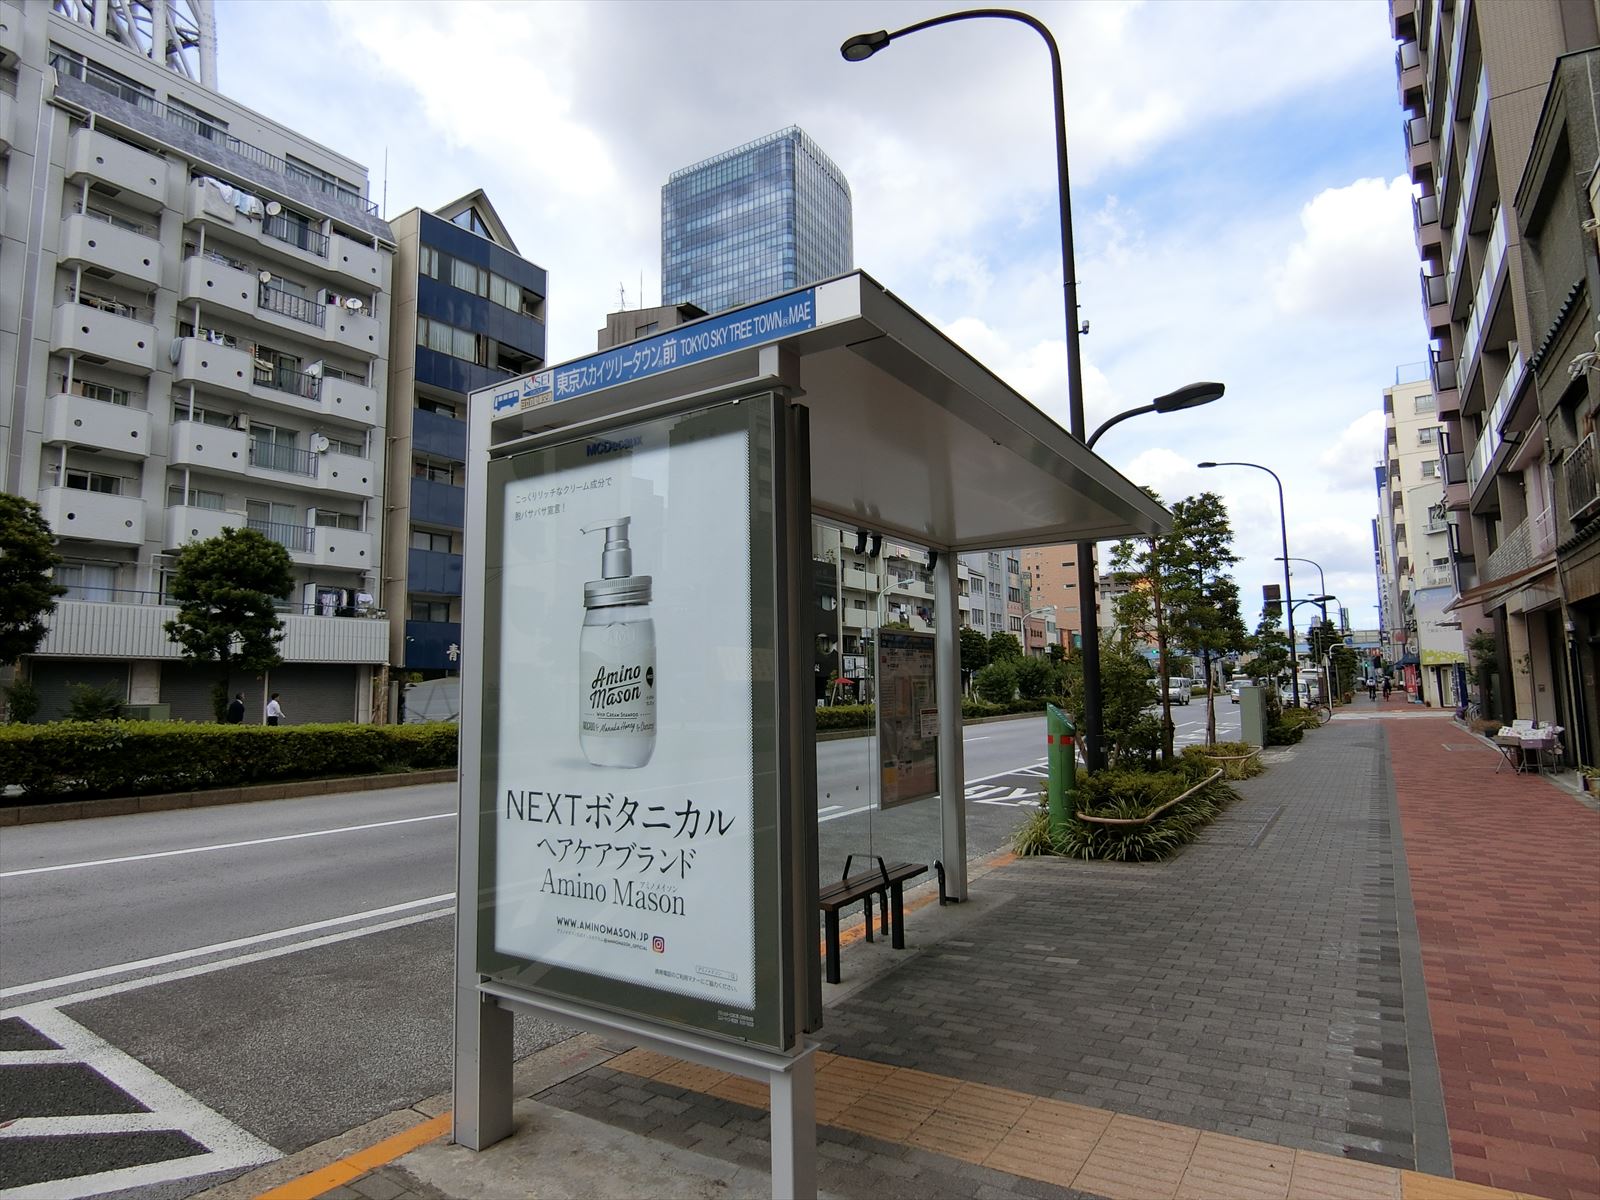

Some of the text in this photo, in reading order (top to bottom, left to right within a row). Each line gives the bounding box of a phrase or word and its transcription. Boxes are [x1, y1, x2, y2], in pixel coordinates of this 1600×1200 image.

[680, 332, 710, 356] TOKYO
[710, 326, 729, 348] SKY
[729, 319, 753, 340] TREE
[789, 301, 811, 324] MAE
[590, 686, 641, 709] Mason
[591, 665, 641, 689] Amino
[506, 789, 736, 839] NEXTボタニカル
[536, 837, 696, 880] ヘアケアブランド
[540, 868, 686, 916] Amino Mason
[556, 916, 649, 942] WWW.AMINOMASON.JP
